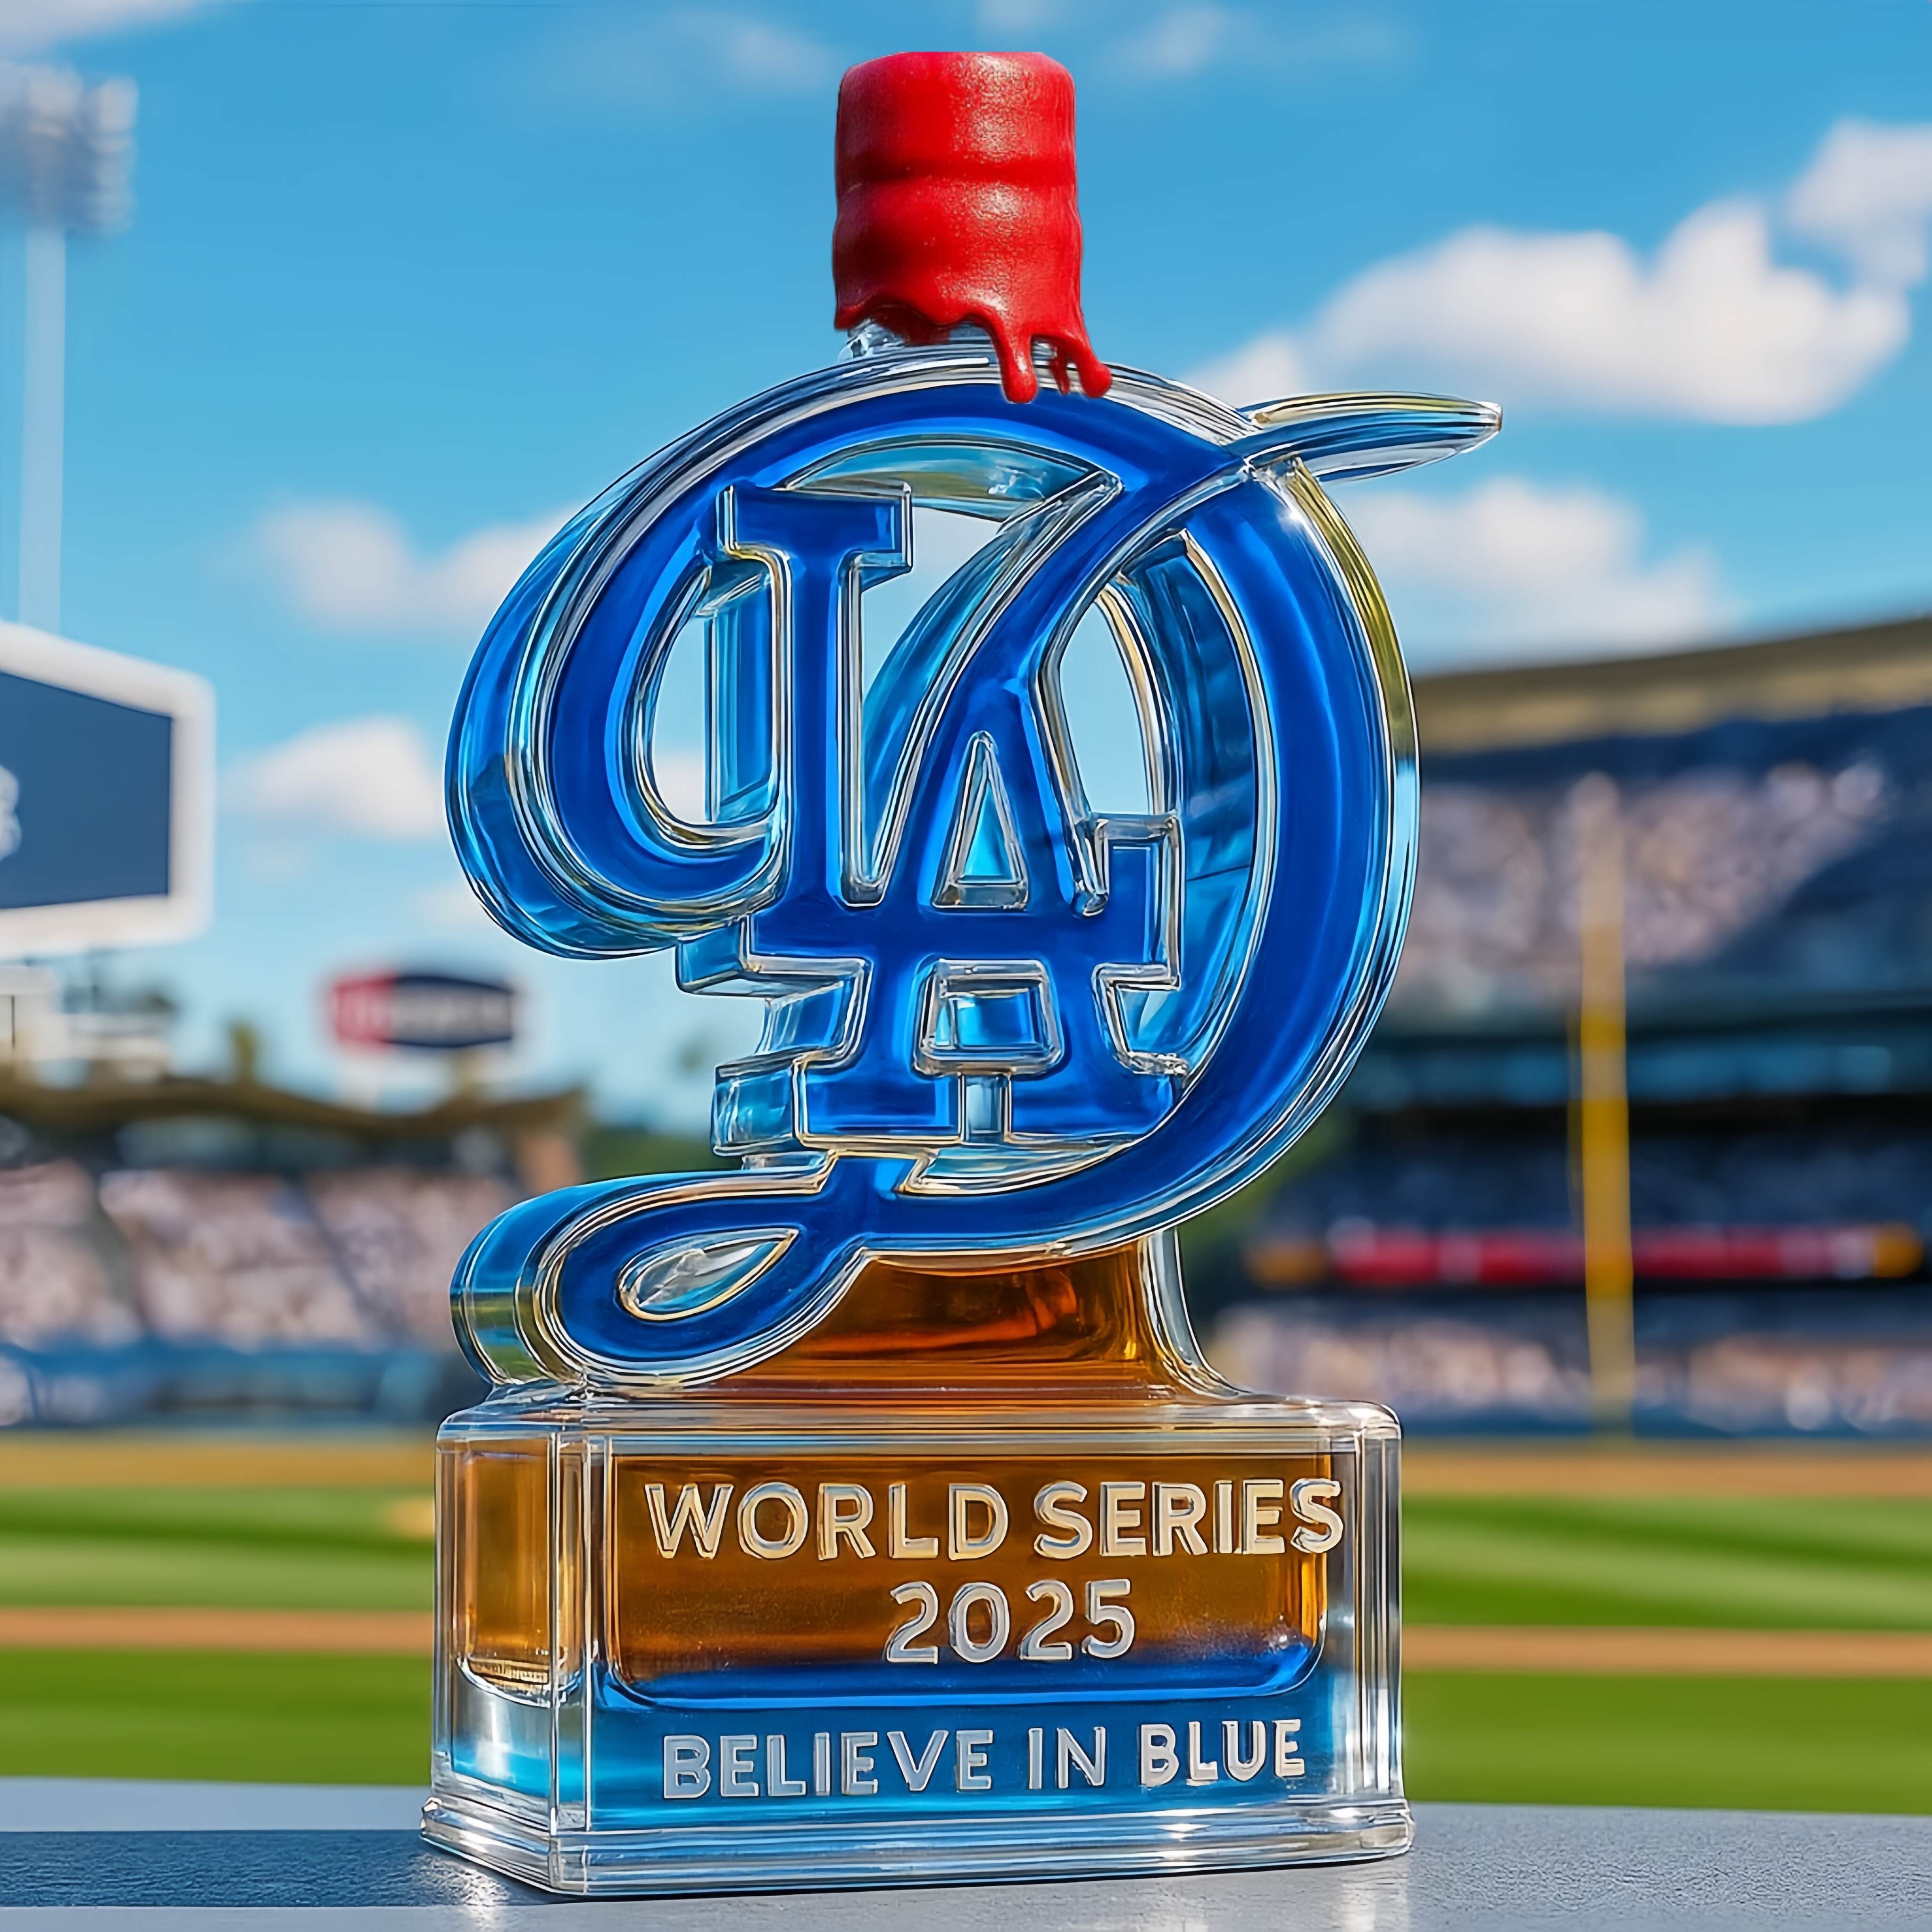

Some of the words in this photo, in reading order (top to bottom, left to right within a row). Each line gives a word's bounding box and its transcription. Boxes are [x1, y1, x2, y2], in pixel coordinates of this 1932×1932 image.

[644, 1482, 1008, 1561] WORLD
[1033, 1478, 1344, 1559] SERIES
[885, 1579, 1135, 1664] 2025
[663, 1730, 994, 1799] BELIEVE
[1028, 1726, 1106, 1789] IN
[1140, 1718, 1305, 1787] BLUE
